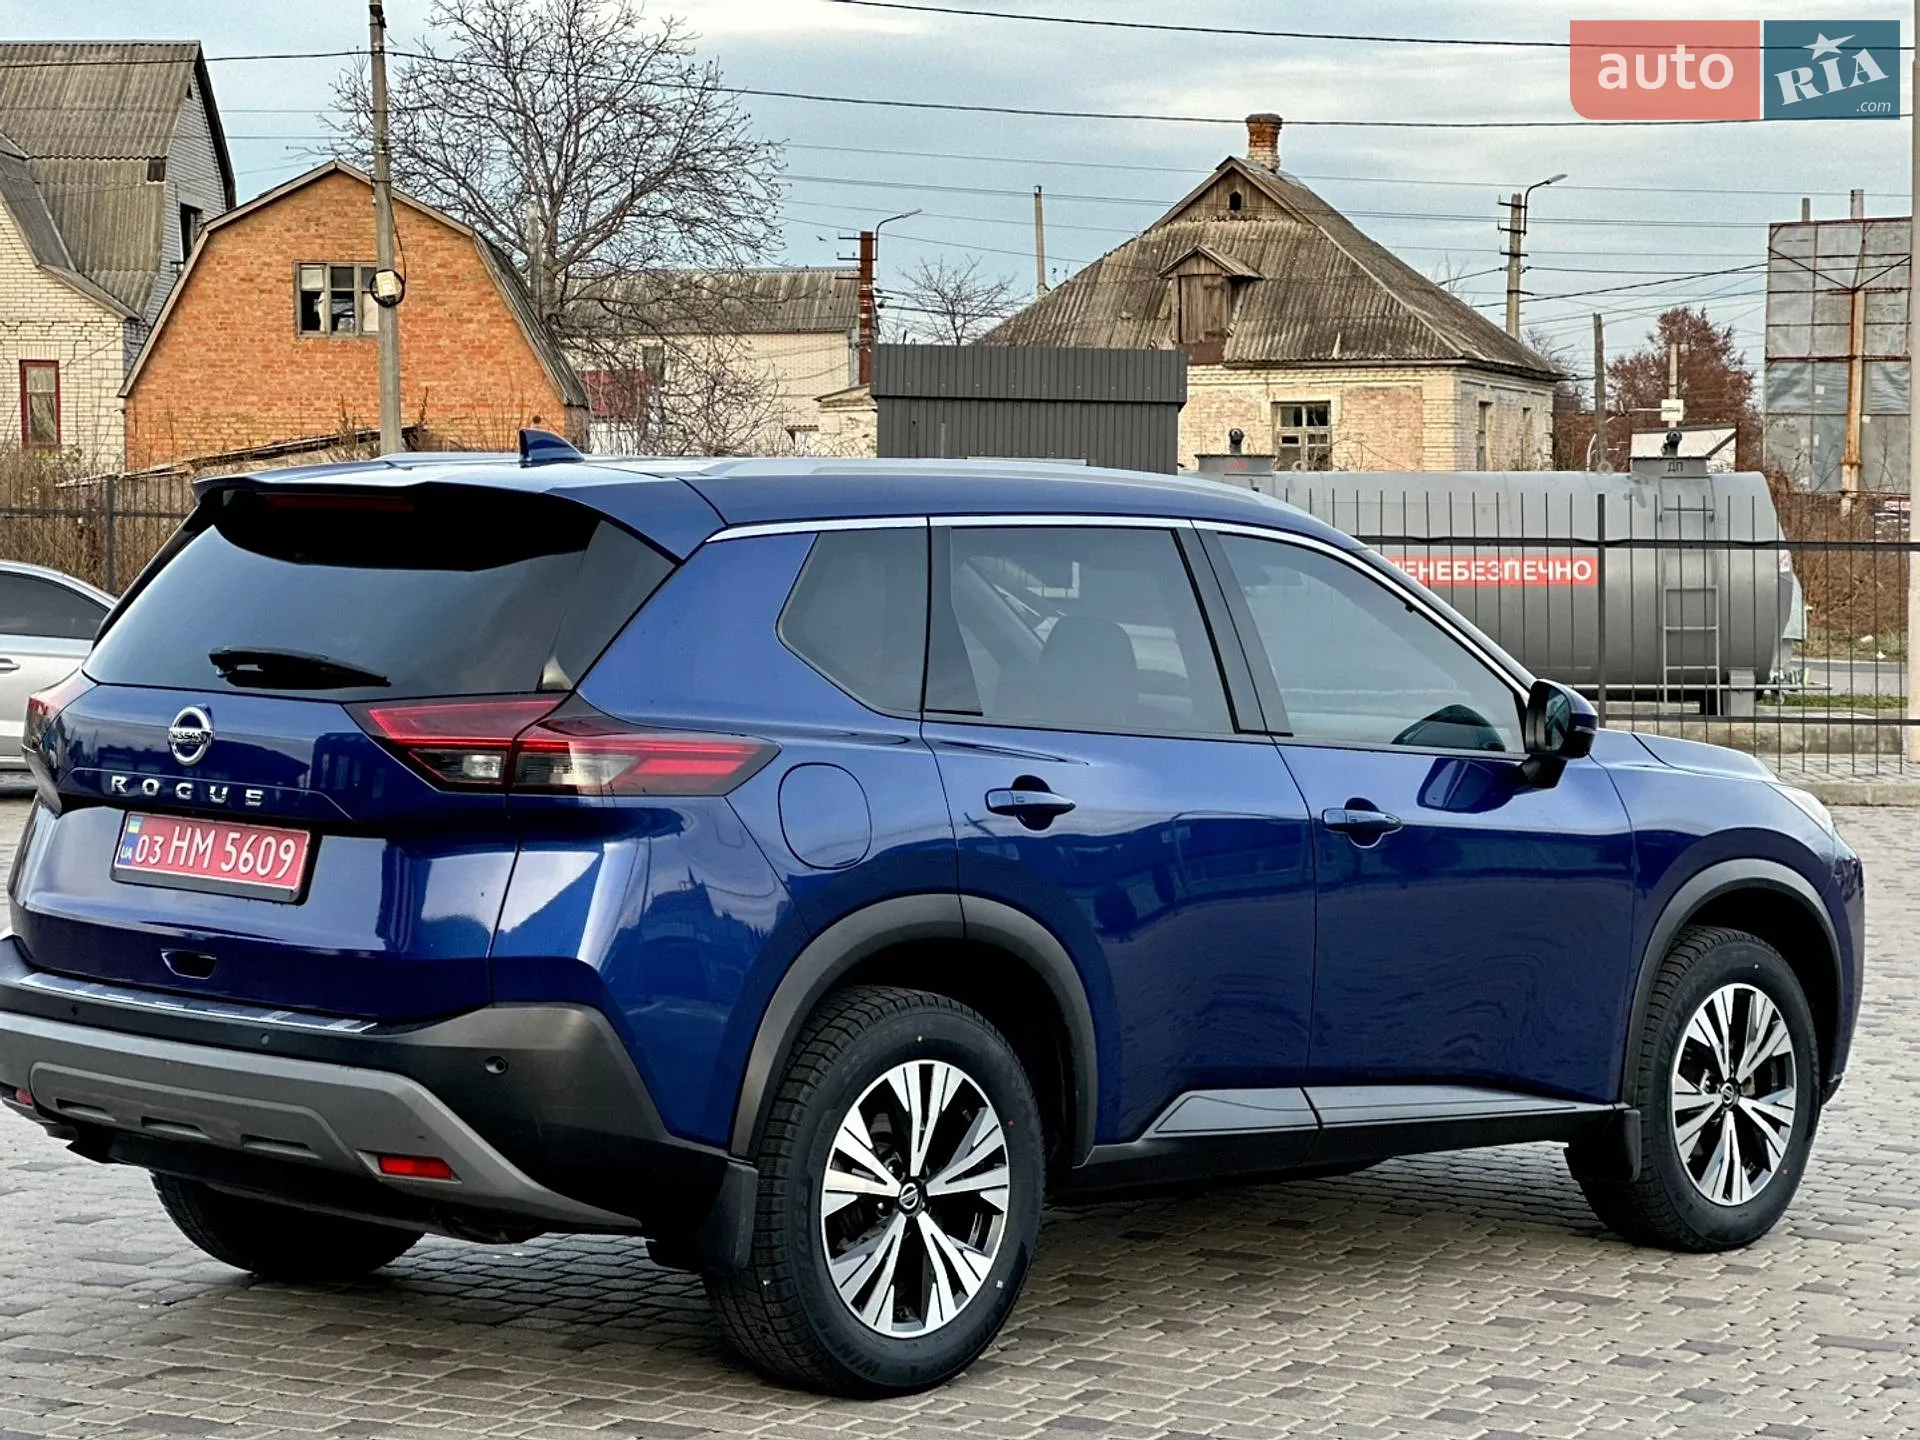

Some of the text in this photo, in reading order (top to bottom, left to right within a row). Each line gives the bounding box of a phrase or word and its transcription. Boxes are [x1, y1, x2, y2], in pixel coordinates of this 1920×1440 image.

[1668, 461, 1683, 472] ДП
[111, 775, 264, 807] ROGUE
[135, 825, 297, 880] 03 HM 5609
